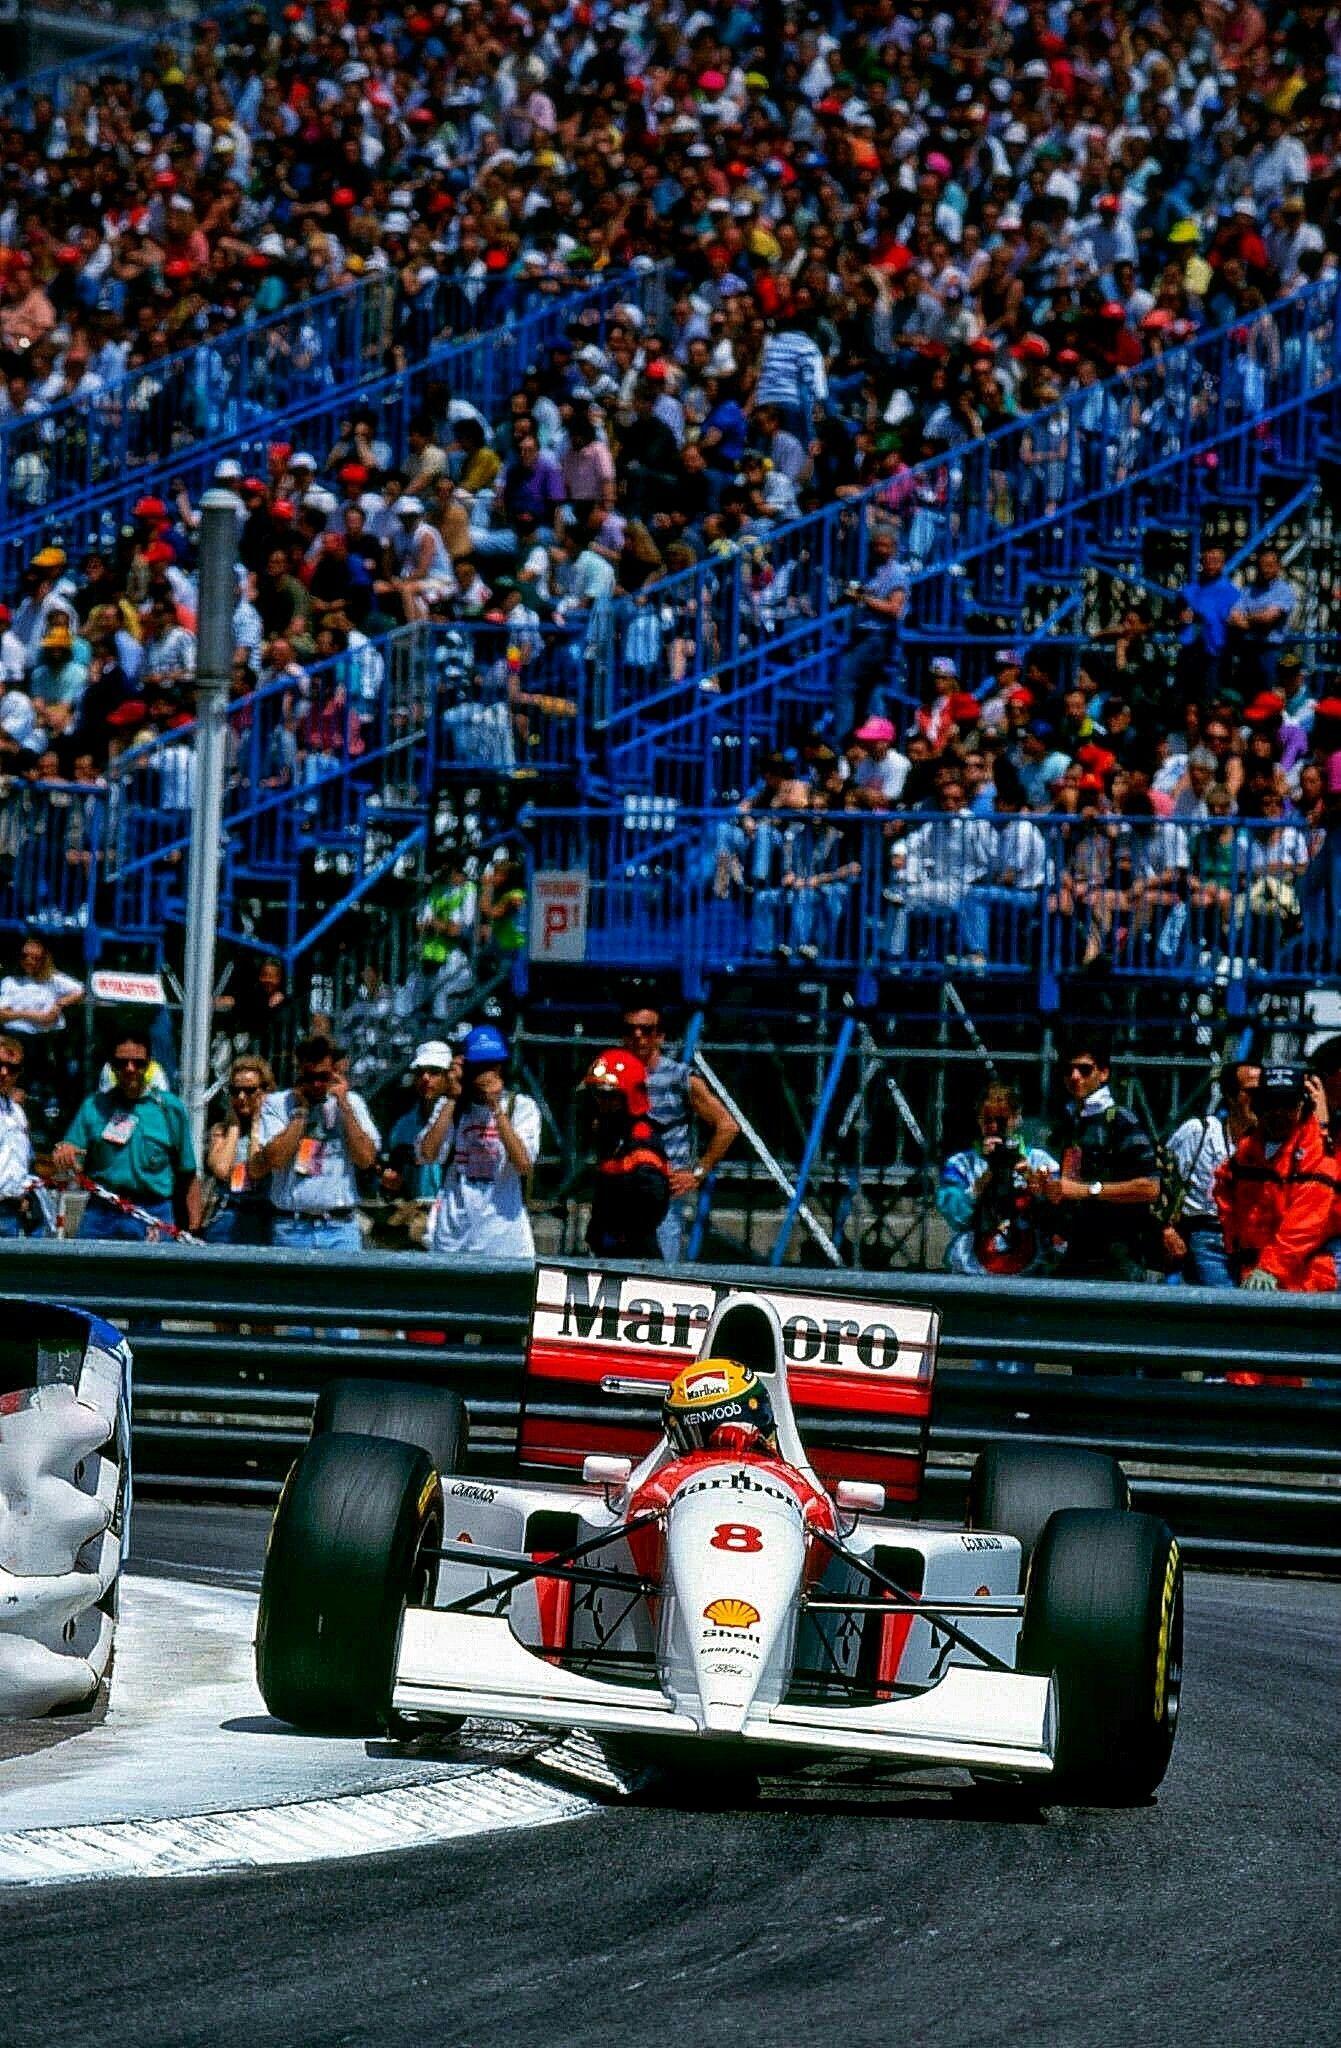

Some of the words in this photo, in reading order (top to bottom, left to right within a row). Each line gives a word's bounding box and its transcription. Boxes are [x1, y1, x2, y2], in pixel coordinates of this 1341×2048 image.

[558, 1271, 899, 1370] Maroro
[683, 1402, 742, 1425] KENWOOD
[710, 1523, 764, 1553] 8
[702, 1629, 760, 1644] Shell
